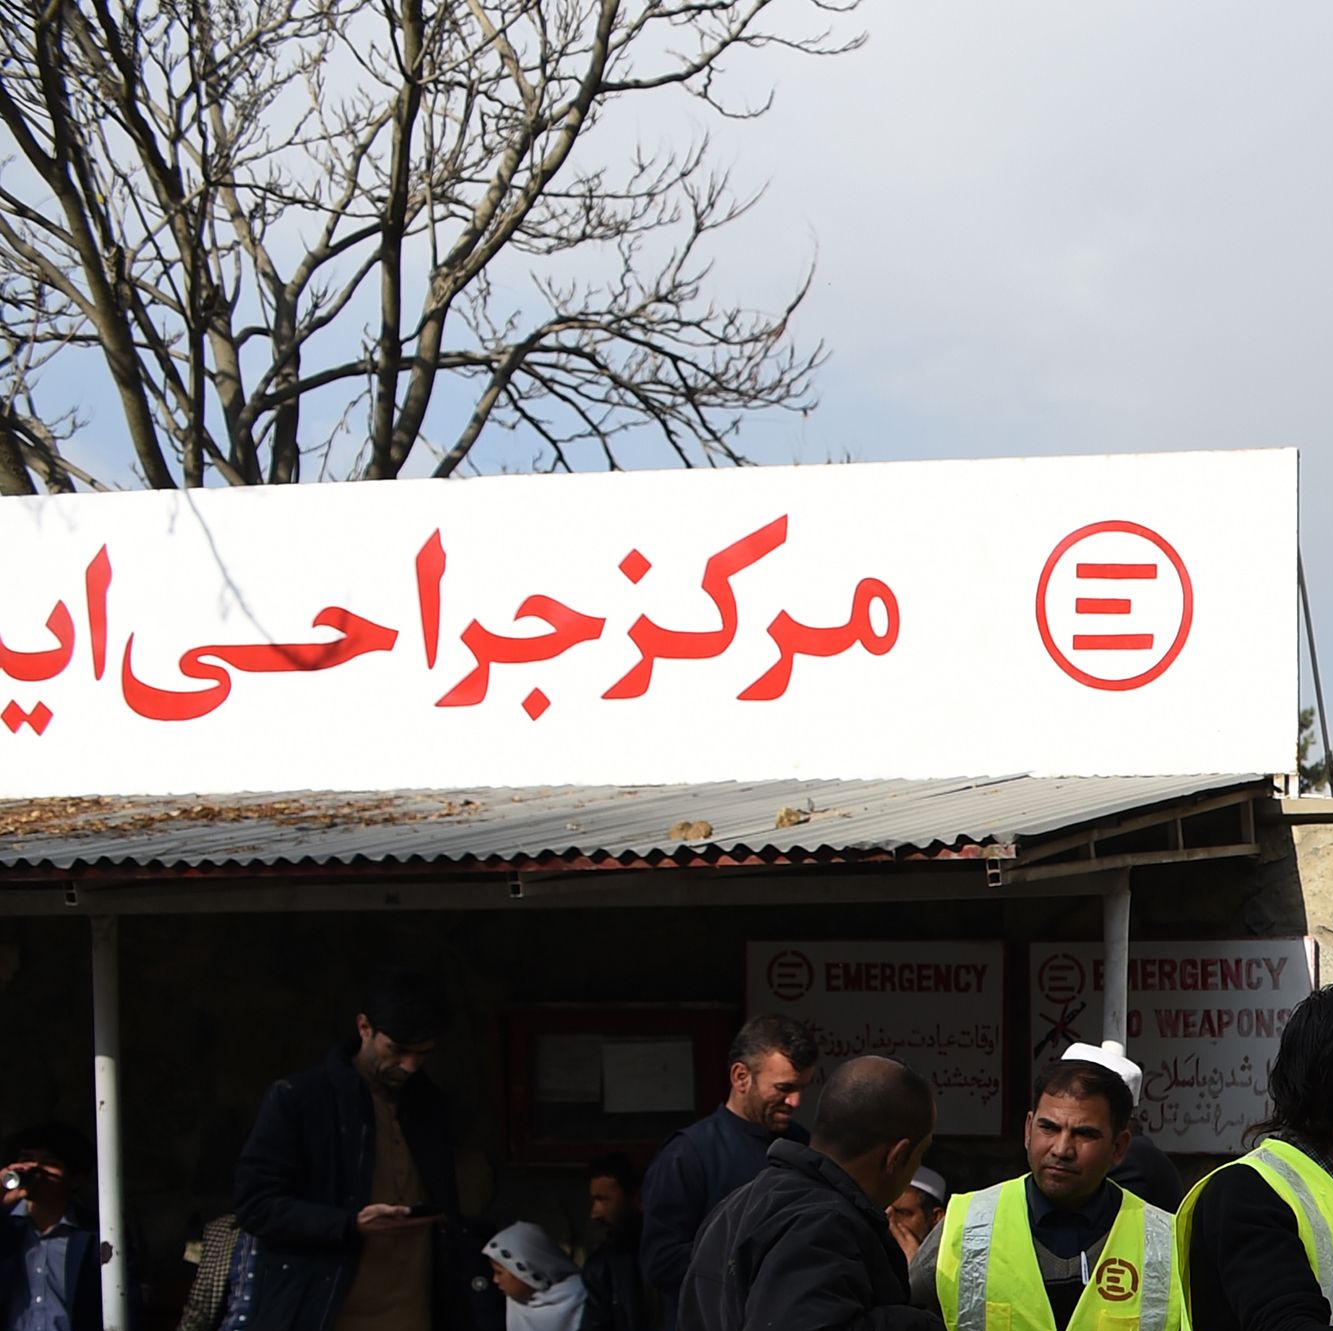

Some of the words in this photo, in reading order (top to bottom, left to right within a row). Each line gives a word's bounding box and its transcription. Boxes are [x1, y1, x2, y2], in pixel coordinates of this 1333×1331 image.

[0, 542, 113, 737] ای
[121, 527, 607, 722] جراحی
[600, 513, 902, 701] مرکز
[825, 962, 988, 992] EMERGENCY
